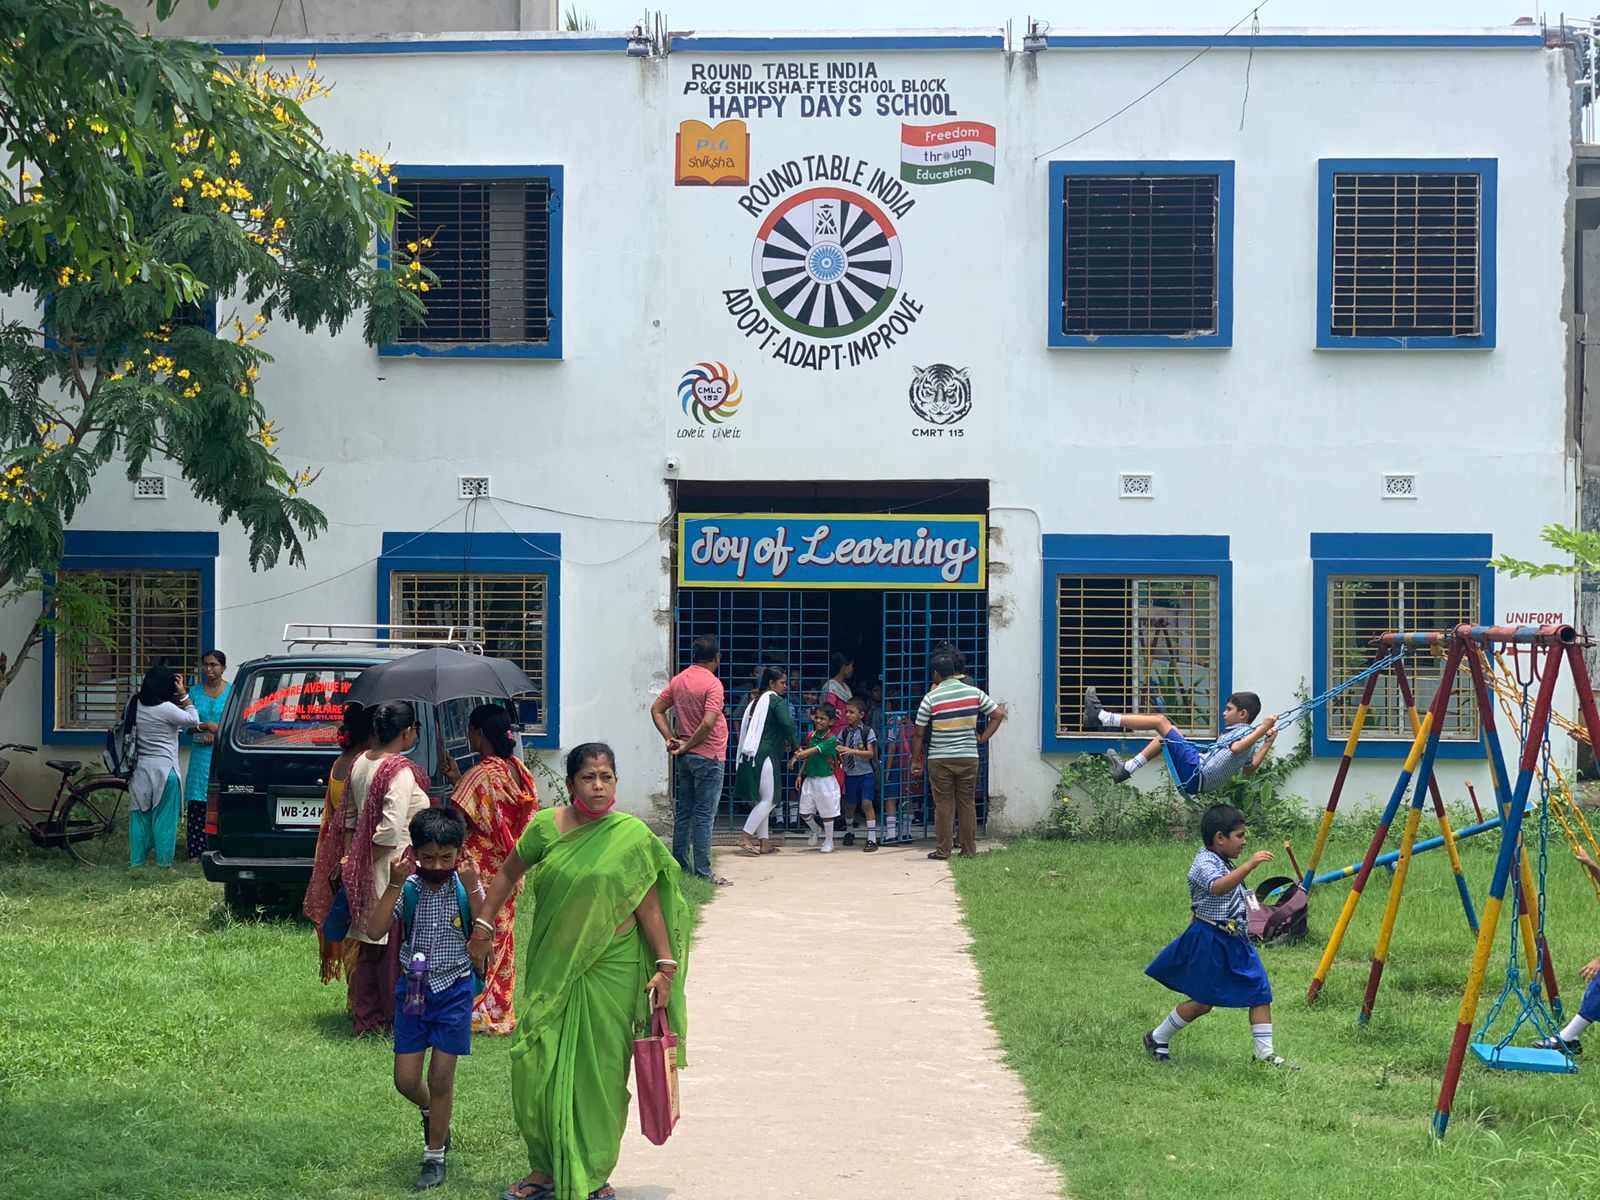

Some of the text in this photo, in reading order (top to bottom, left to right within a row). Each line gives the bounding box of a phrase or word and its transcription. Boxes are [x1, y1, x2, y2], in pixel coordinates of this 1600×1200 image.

[691, 61, 878, 81] ROUND TABLE INDIA
[901, 78, 947, 93] BLOCK
[708, 93, 958, 119] HAPPY DAYS SCHOOL
[924, 145, 972, 161] through
[916, 166, 972, 180] Education
[737, 154, 916, 220] ROUND TABLE INDIA
[697, 386, 722, 394] CMLC
[912, 428, 944, 437] CMRT
[691, 524, 978, 583] Joy of Learning
[1506, 612, 1563, 625] UNIFORM
